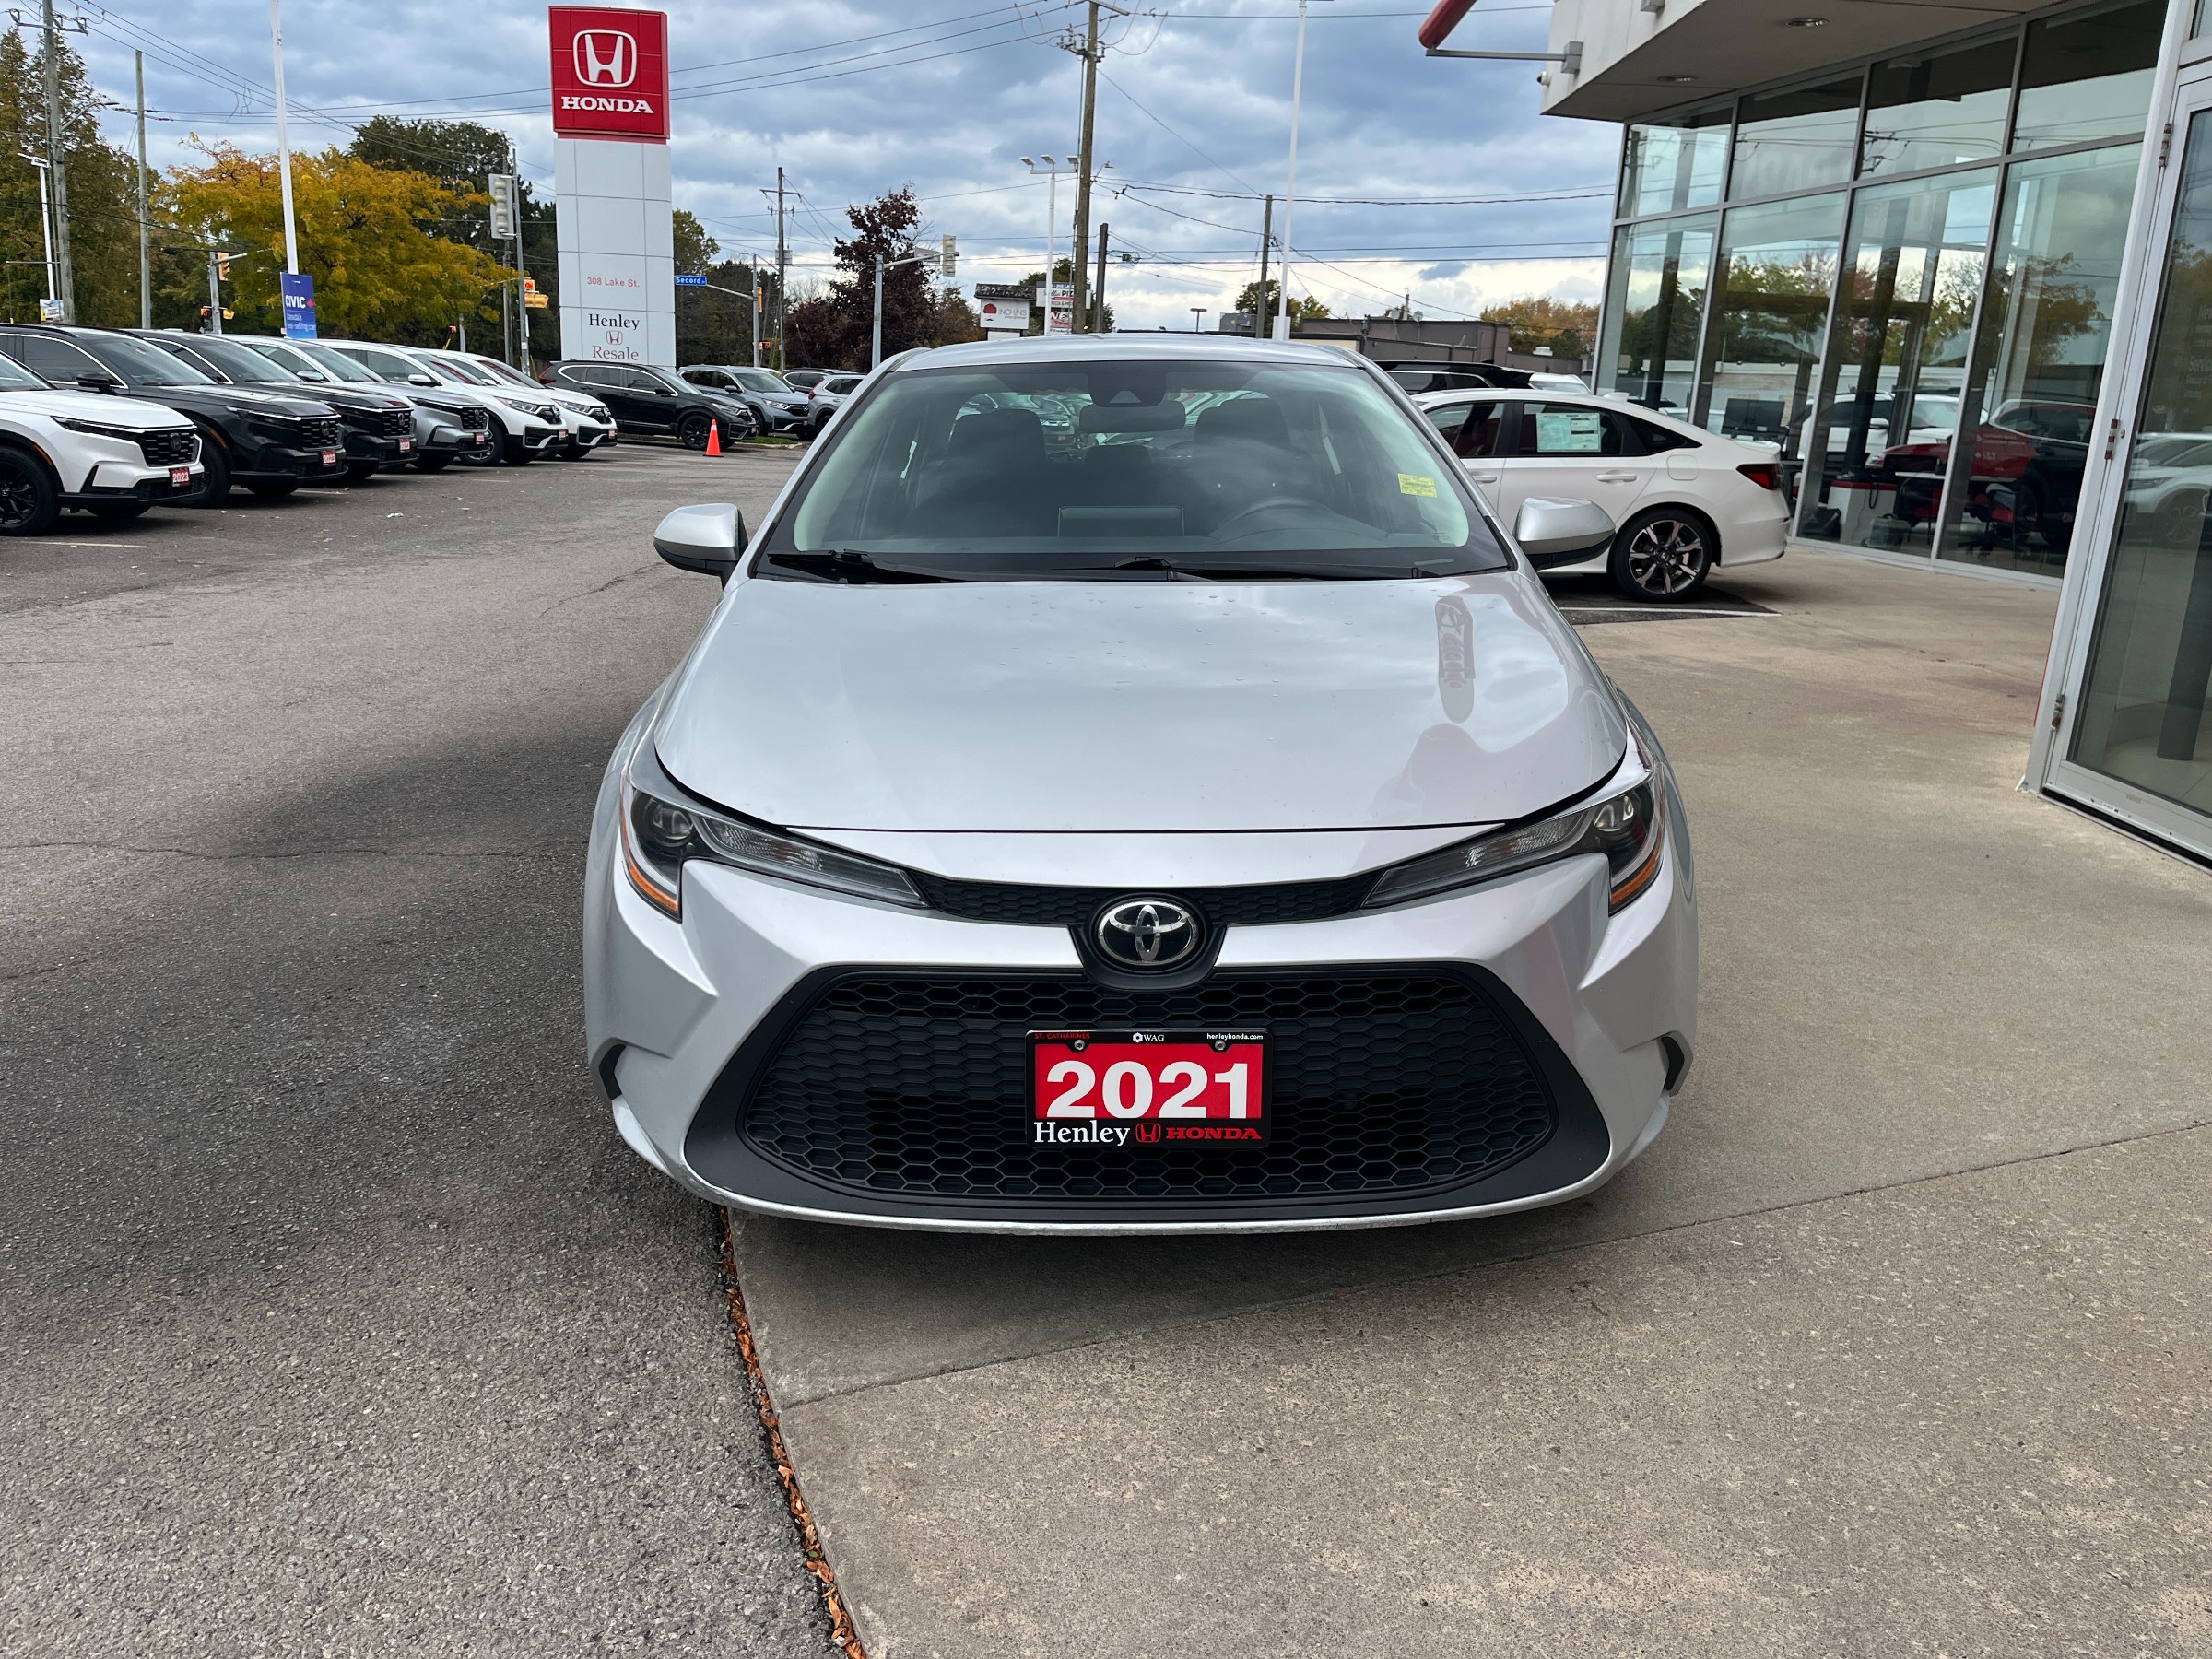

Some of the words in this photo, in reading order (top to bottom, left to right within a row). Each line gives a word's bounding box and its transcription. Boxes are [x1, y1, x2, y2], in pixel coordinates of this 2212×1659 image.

[561, 96, 654, 113] HONDA
[586, 276, 602, 286] 308
[605, 277, 625, 287] Lake
[628, 278, 640, 288] St.
[285, 294, 306, 309] CIVIC
[588, 313, 640, 330] Henley
[592, 345, 639, 360] Resale
[172, 471, 189, 482] 2023
[1206, 1032, 1264, 1041] henleyhonda.com
[1046, 1060, 1248, 1119] 2021
[1033, 1120, 1130, 1146] Henley
[1166, 1127, 1262, 1140] HONDA
